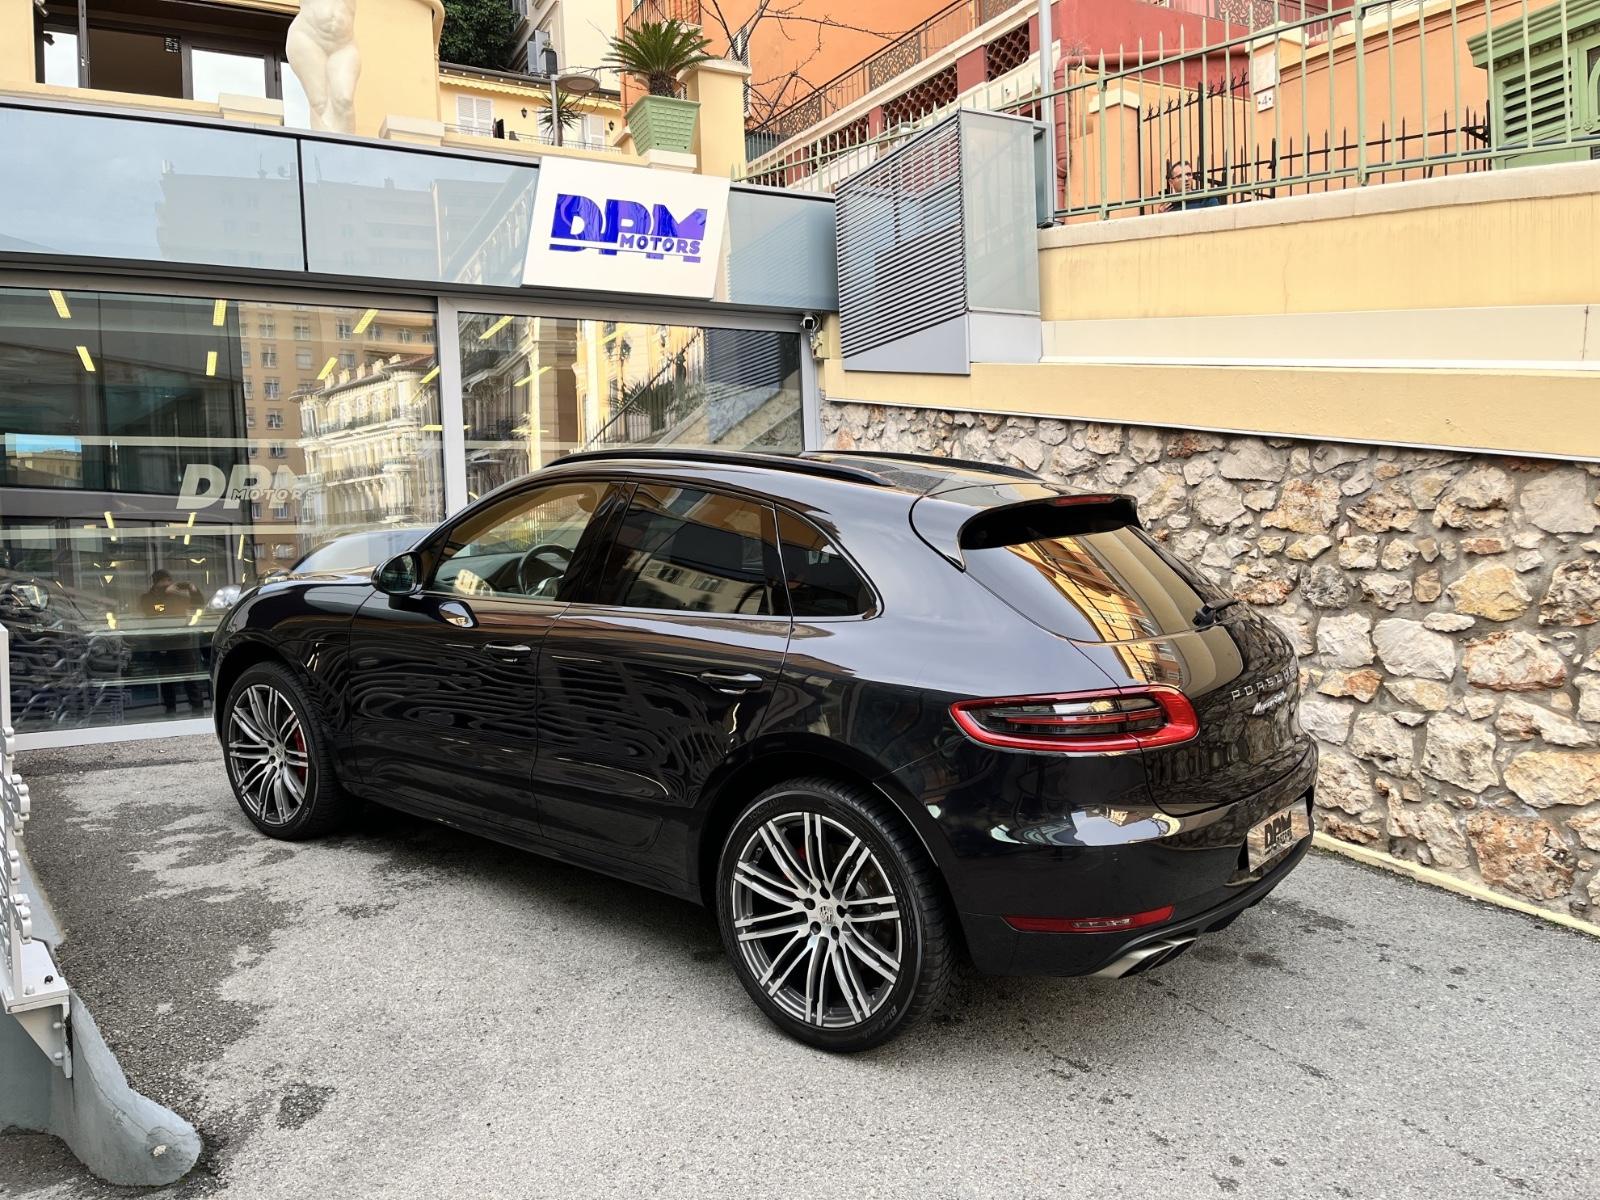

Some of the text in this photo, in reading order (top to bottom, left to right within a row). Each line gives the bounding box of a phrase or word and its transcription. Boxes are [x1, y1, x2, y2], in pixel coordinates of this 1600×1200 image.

[549, 193, 708, 263] DPM
[619, 234, 701, 255] MOTORS
[231, 488, 315, 501] MOTORS
[1264, 809, 1292, 855] DPM
